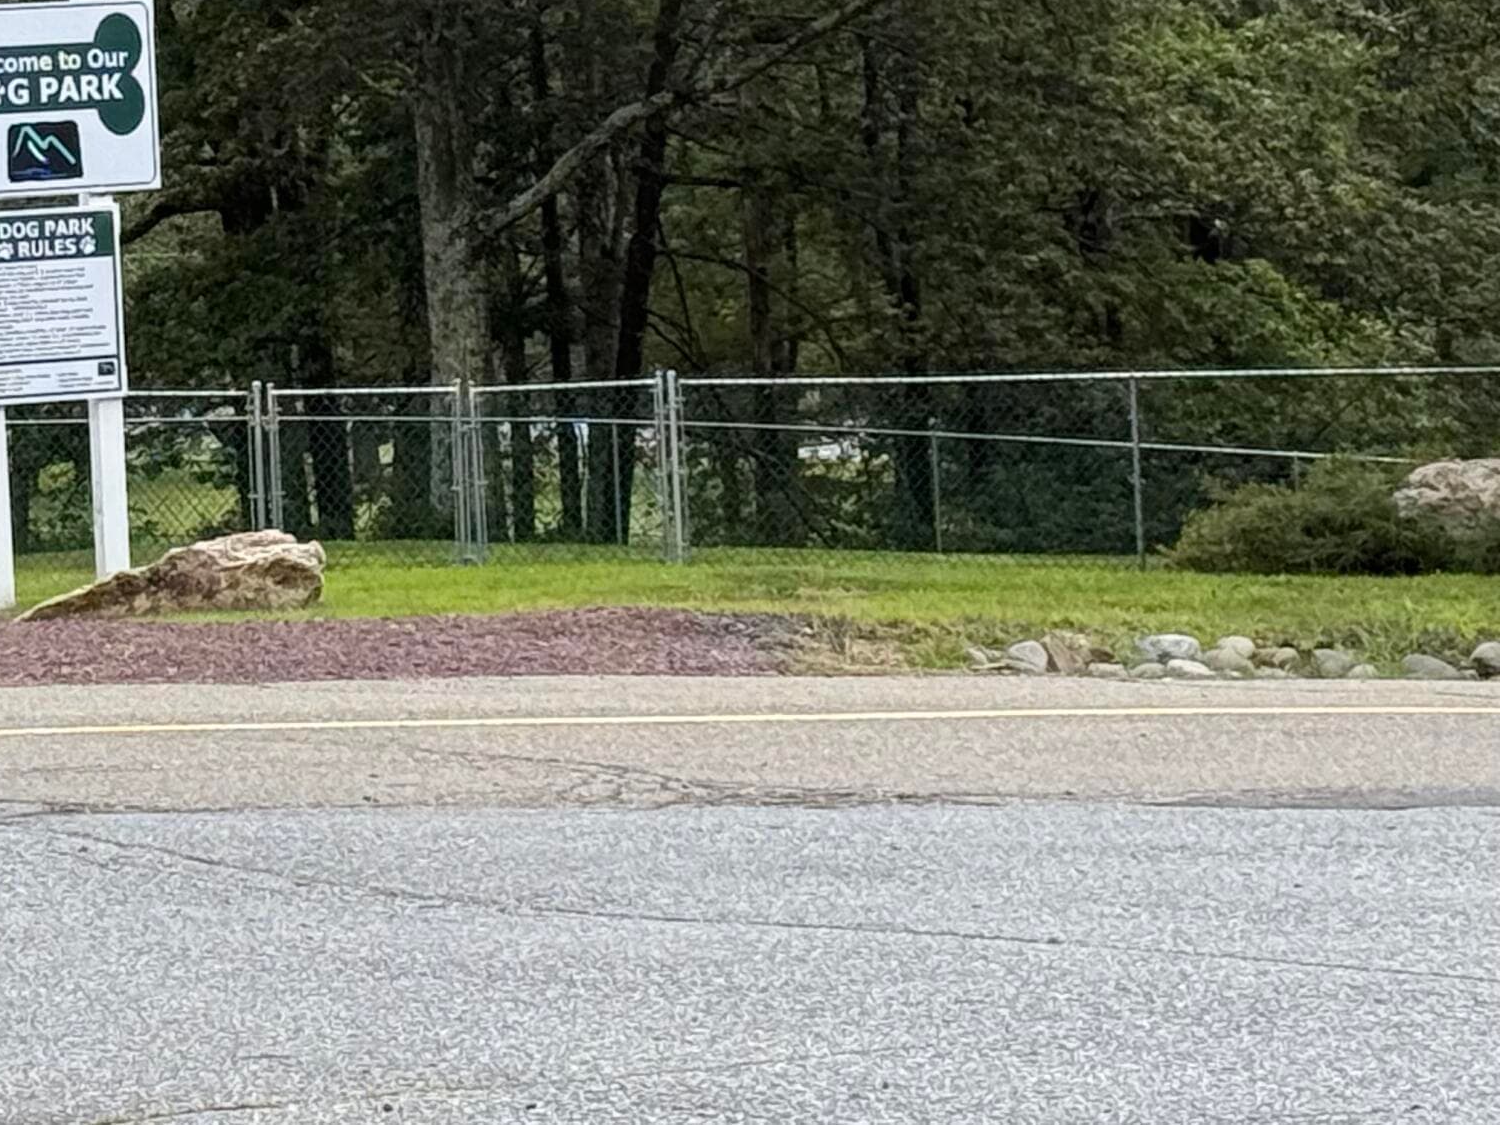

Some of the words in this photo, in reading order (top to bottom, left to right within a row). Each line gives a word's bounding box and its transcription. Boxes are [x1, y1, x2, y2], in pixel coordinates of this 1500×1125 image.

[58, 50, 81, 70] to
[87, 48, 129, 69] Our
[39, 72, 124, 103] PARK
[45, 217, 95, 236] PARK
[17, 238, 77, 257] RULES
